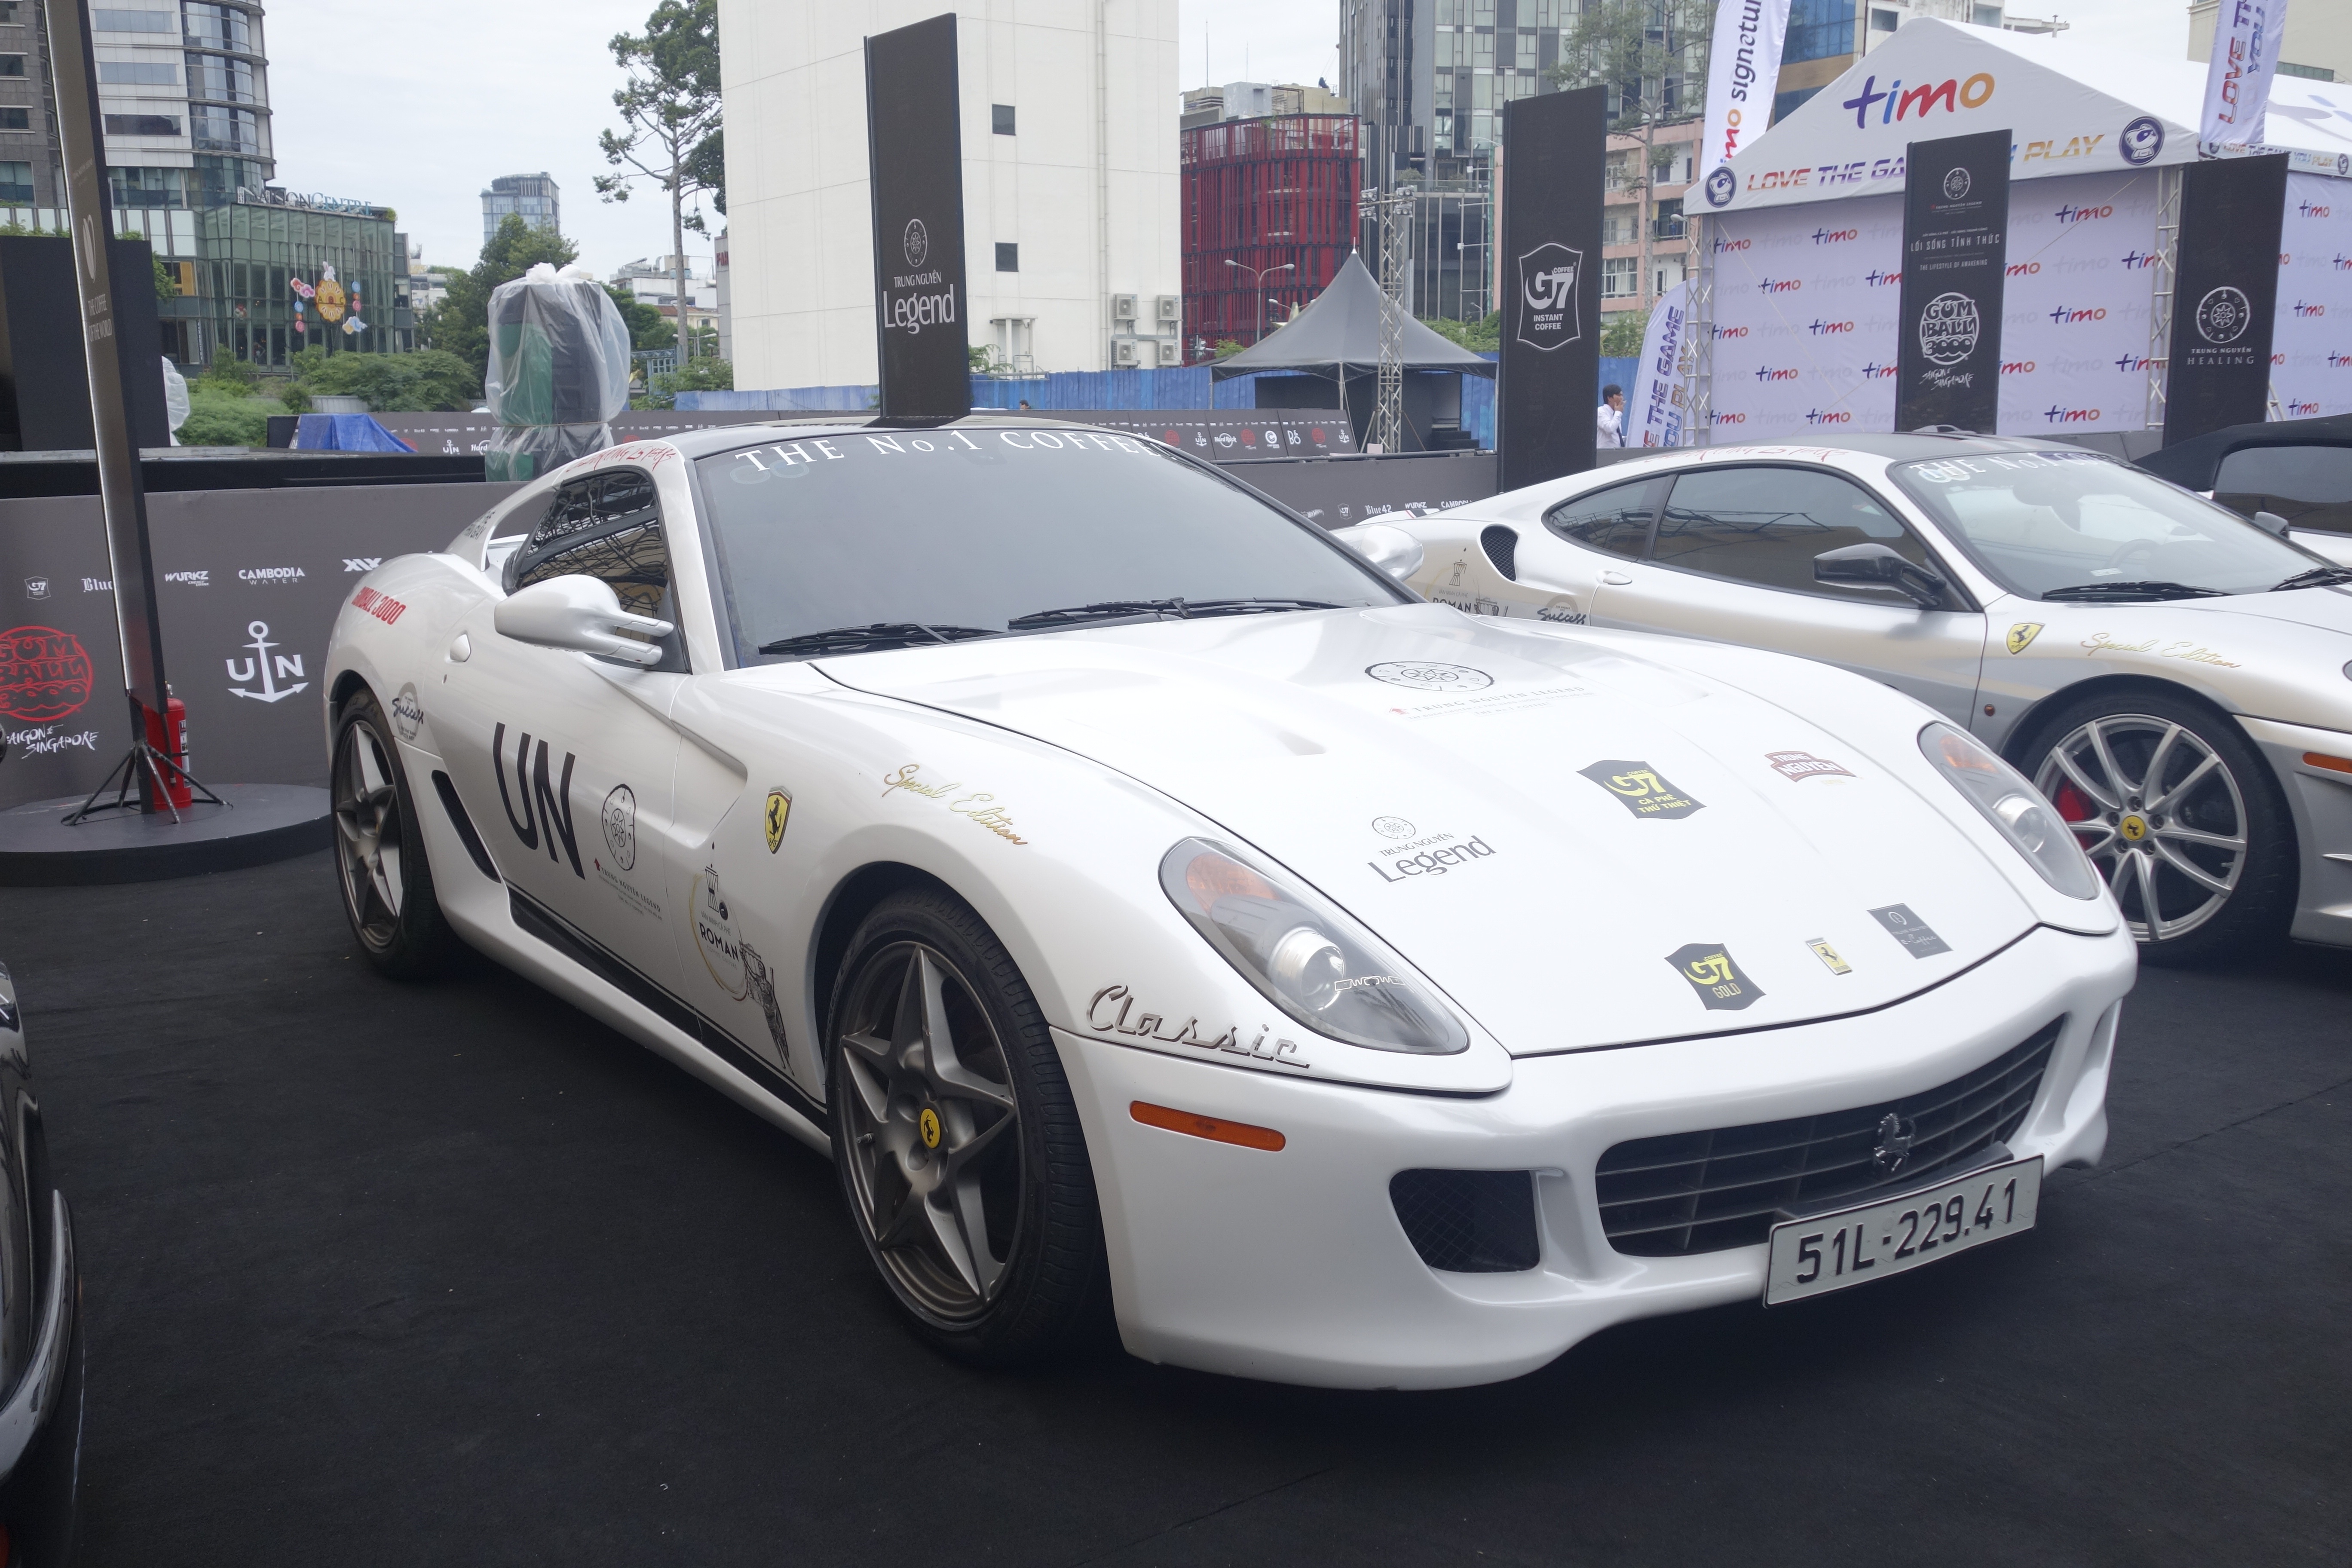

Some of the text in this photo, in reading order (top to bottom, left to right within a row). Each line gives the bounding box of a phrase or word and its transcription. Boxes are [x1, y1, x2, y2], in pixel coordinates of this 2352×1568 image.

[2218, 36, 2246, 124] LOVE
[1843, 72, 1995, 129] timo
[2023, 134, 2105, 164] PLAY
[1747, 168, 1811, 191] LOVE
[1818, 162, 1866, 187] THE
[2055, 204, 2113, 224] timo
[2299, 199, 2330, 218] timo
[1713, 237, 1751, 254] timo
[1812, 228, 1858, 245] timo
[1929, 261, 1952, 270] LIFESTYLE
[1961, 259, 1988, 267] AWAKENING
[894, 269, 942, 288] TRUNG NGUYÊN
[1525, 270, 1574, 309] G7
[1758, 278, 1801, 294] timo
[1865, 270, 1902, 287] tim
[883, 284, 955, 334] Legend
[2049, 306, 2107, 324] timo
[2294, 299, 2324, 318] timo
[1708, 325, 1749, 340] timo
[1809, 319, 1854, 336] timo
[1923, 318, 1975, 339] BALL
[1657, 306, 1684, 377] GAME
[2187, 356, 2254, 365] HEALING
[2328, 350, 2352, 368] tim
[1755, 366, 1798, 382] timo
[1862, 362, 1898, 380] tim
[1647, 379, 1669, 425] THE
[2288, 398, 2319, 416] timo
[1705, 410, 1746, 425] timo
[1806, 408, 1851, 425] timo
[2044, 404, 2100, 423] timo
[735, 440, 844, 472] THE
[1909, 459, 1987, 479] THE
[165, 570, 209, 582] WURKZ
[238, 567, 306, 580] CAMBODIA
[28, 582, 46, 591] G7
[371, 595, 406, 625] 3000
[1537, 607, 1587, 624] Success
[2081, 633, 2242, 668] Special Edition
[226, 654, 304, 681] UN
[1412, 686, 1585, 713] TRUNG NGUYÊN LEGEND
[6, 724, 46, 745] AIGON
[21, 731, 99, 759] SINGAPORE
[1773, 753, 1812, 763] TRUNG
[1777, 760, 1844, 776] NGUYÊN
[1603, 772, 1666, 796] G7
[493, 721, 586, 880] UN
[882, 764, 1029, 846] Special Edition
[1654, 793, 1677, 802] PHÊ
[1660, 800, 1692, 809] THIỆT
[1378, 833, 1455, 857] TRUNG NGUYÊN
[1367, 835, 1497, 882] Legend
[601, 867, 661, 913] TRUNG NGUYÊN LEGEND
[699, 922, 739, 962] ROMAN
[1704, 953, 1724, 961] COFFEE
[1684, 956, 1734, 985] G7
[1712, 982, 1742, 999] GOLD
[1086, 983, 1311, 1069] Classic
[1797, 1177, 2018, 1284] 51L-229.41
